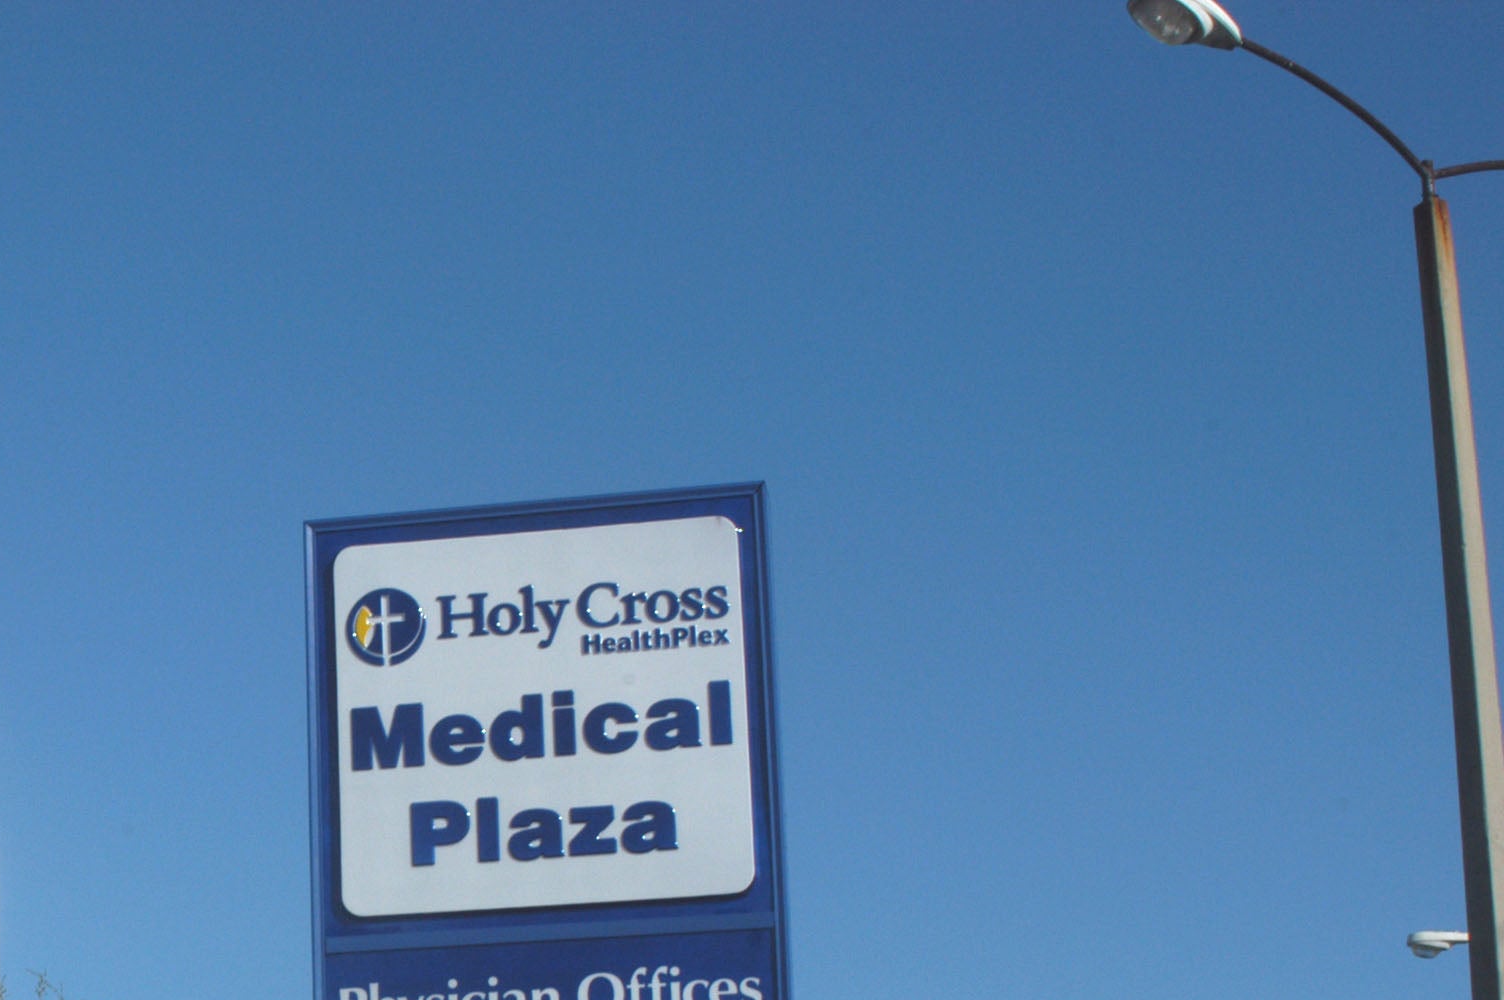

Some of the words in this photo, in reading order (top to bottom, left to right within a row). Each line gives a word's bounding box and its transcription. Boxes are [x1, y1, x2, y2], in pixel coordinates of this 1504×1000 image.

[435, 585, 569, 648] Holy
[577, 582, 731, 627] Cross
[581, 627, 730, 655] HealthPlex
[350, 679, 733, 771] Medical
[410, 796, 679, 867] Plaza
